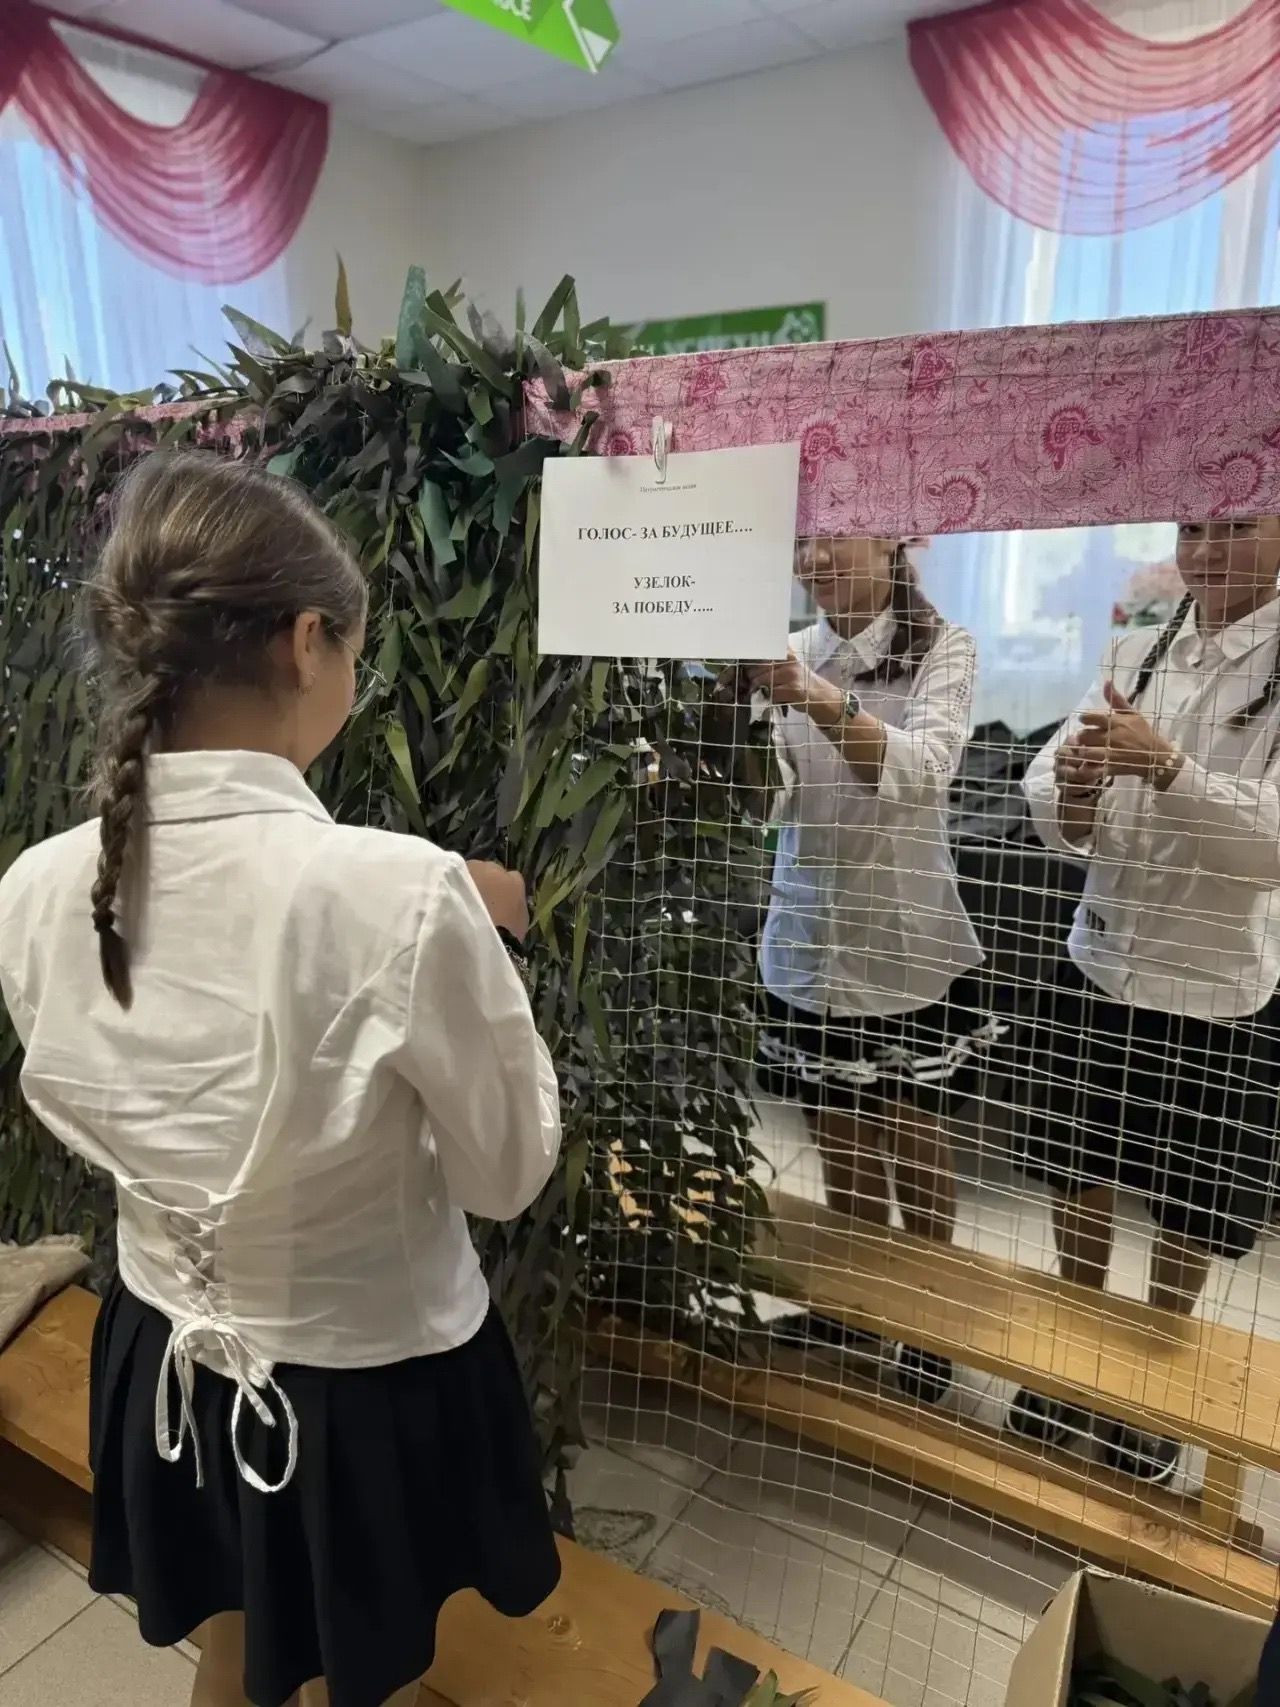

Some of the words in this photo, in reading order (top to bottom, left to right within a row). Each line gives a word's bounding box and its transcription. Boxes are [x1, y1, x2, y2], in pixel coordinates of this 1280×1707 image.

[578, 527, 637, 540] ГОЛОС-
[640, 526, 658, 540] ЗА
[634, 575, 696, 589] УЗЕЛОК-
[612, 601, 630, 614] ЗА
